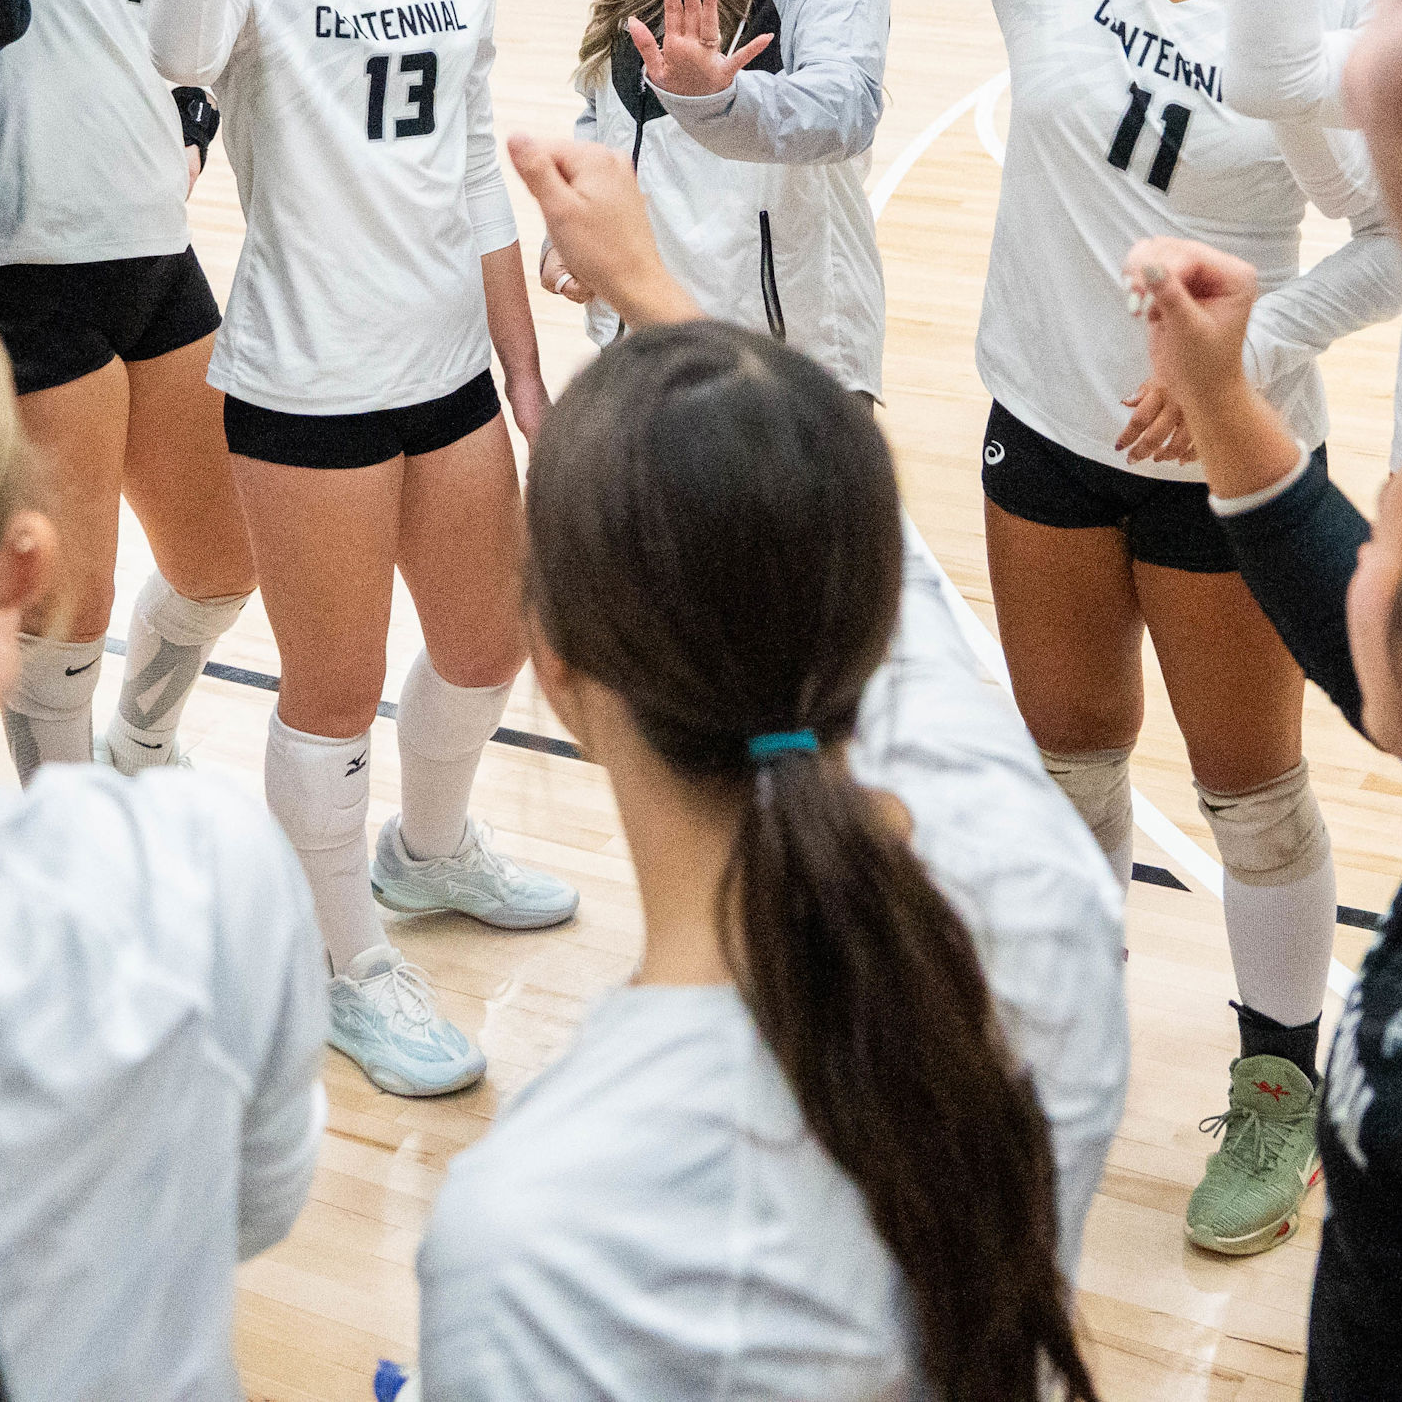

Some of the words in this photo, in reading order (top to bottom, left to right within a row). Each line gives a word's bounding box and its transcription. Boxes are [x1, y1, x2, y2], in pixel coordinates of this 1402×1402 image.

[316, 0, 468, 41] CENTENNIAL
[365, 50, 438, 142] 13
[1106, 80, 1193, 194] 11
